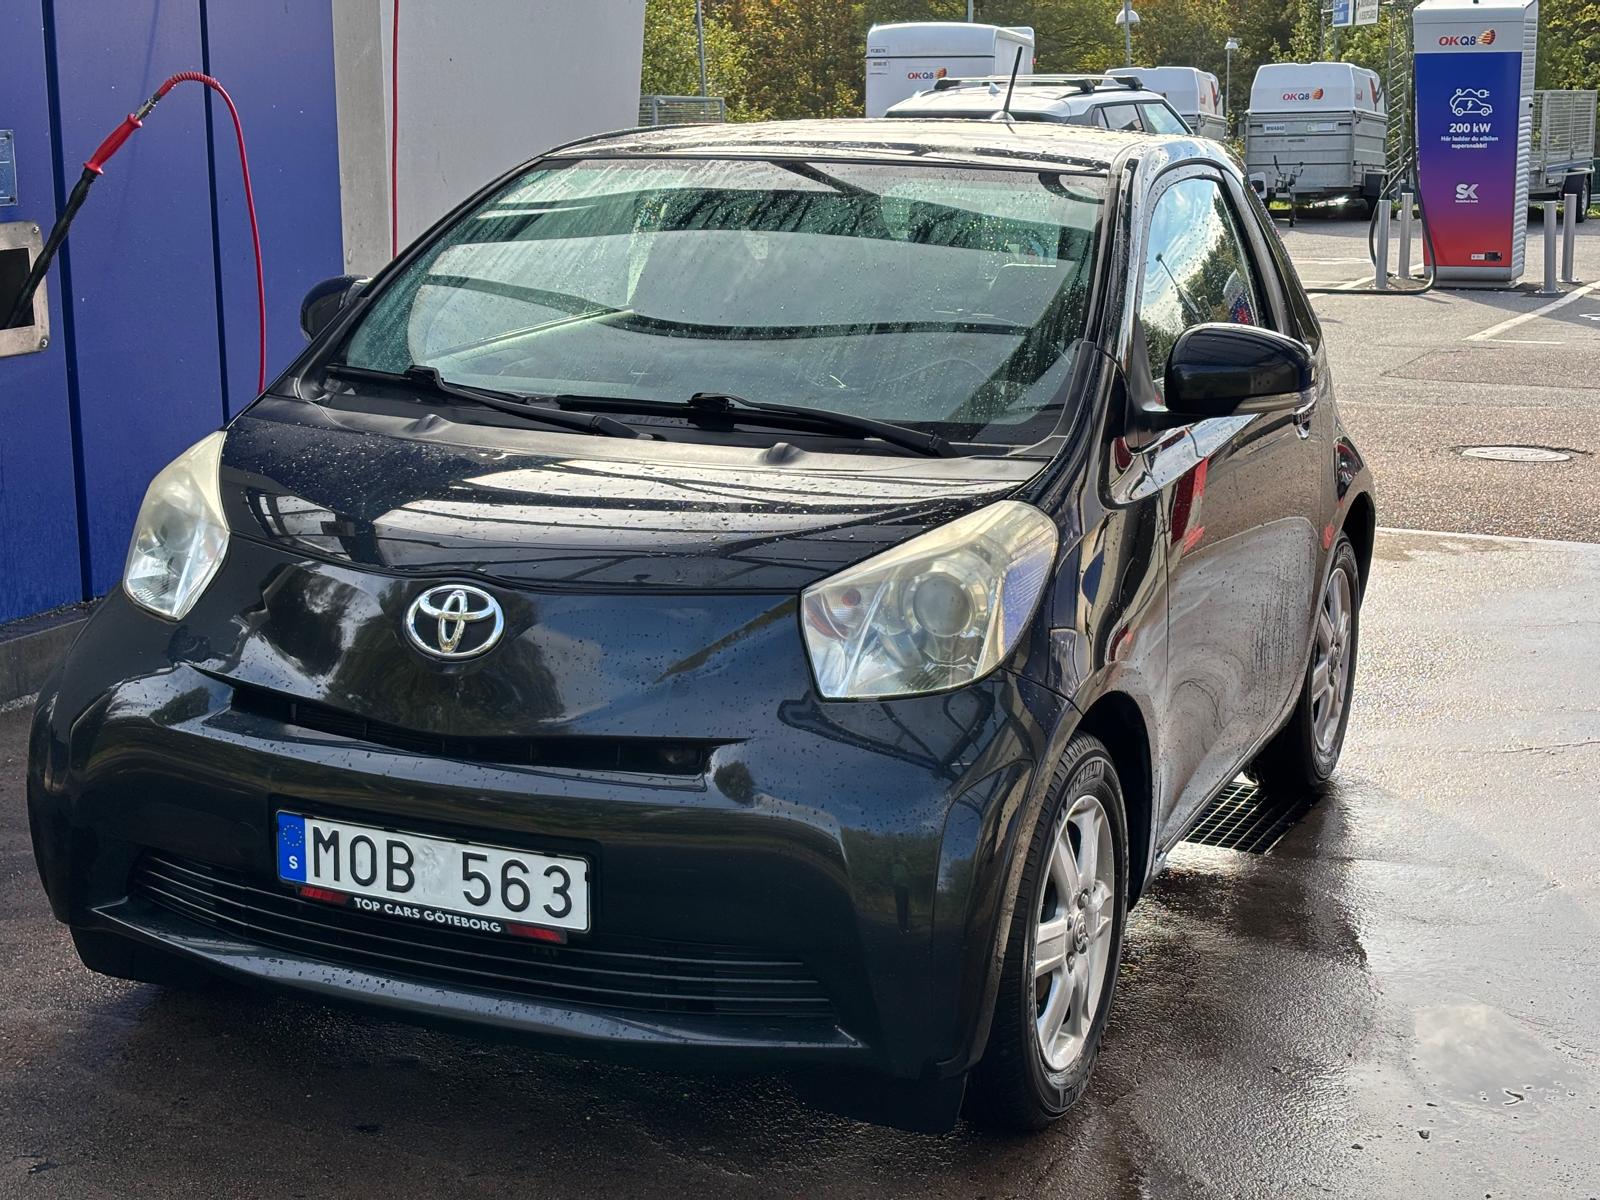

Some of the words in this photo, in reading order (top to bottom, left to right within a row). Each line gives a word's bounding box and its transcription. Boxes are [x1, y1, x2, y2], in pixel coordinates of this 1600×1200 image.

[1438, 35, 1477, 46] OKQ8
[1282, 92, 1310, 101] OKQ8
[1449, 122, 1471, 133] 200
[1472, 122, 1491, 133] kW
[1455, 183, 1479, 199] SK
[288, 855, 298, 870] S
[312, 826, 415, 893] MOB
[462, 851, 572, 918] 563
[353, 896, 381, 913] TOP
[384, 903, 420, 920] CARS
[423, 909, 502, 934] GÖTEBORG
